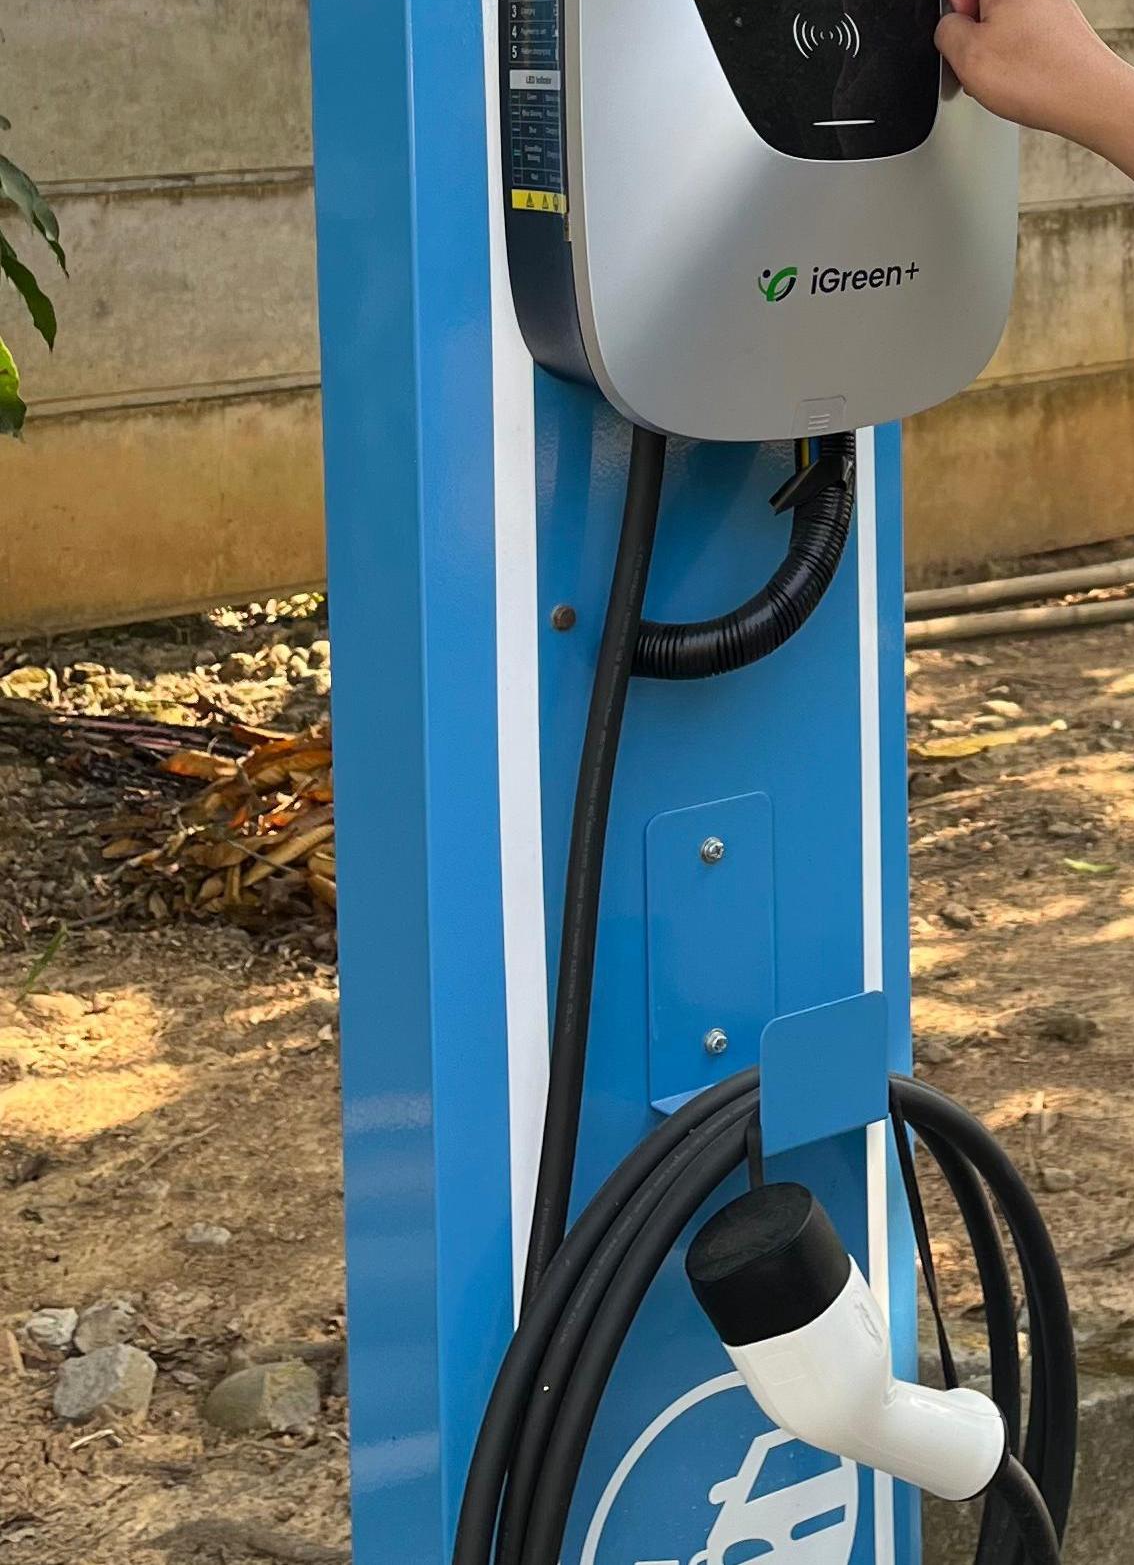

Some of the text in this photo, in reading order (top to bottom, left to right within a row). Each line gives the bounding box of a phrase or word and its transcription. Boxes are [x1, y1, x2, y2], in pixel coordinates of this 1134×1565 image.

[511, 5, 518, 19] 3
[511, 25, 518, 39] 4
[511, 45, 518, 59] 5
[811, 261, 920, 295] iGreen+
